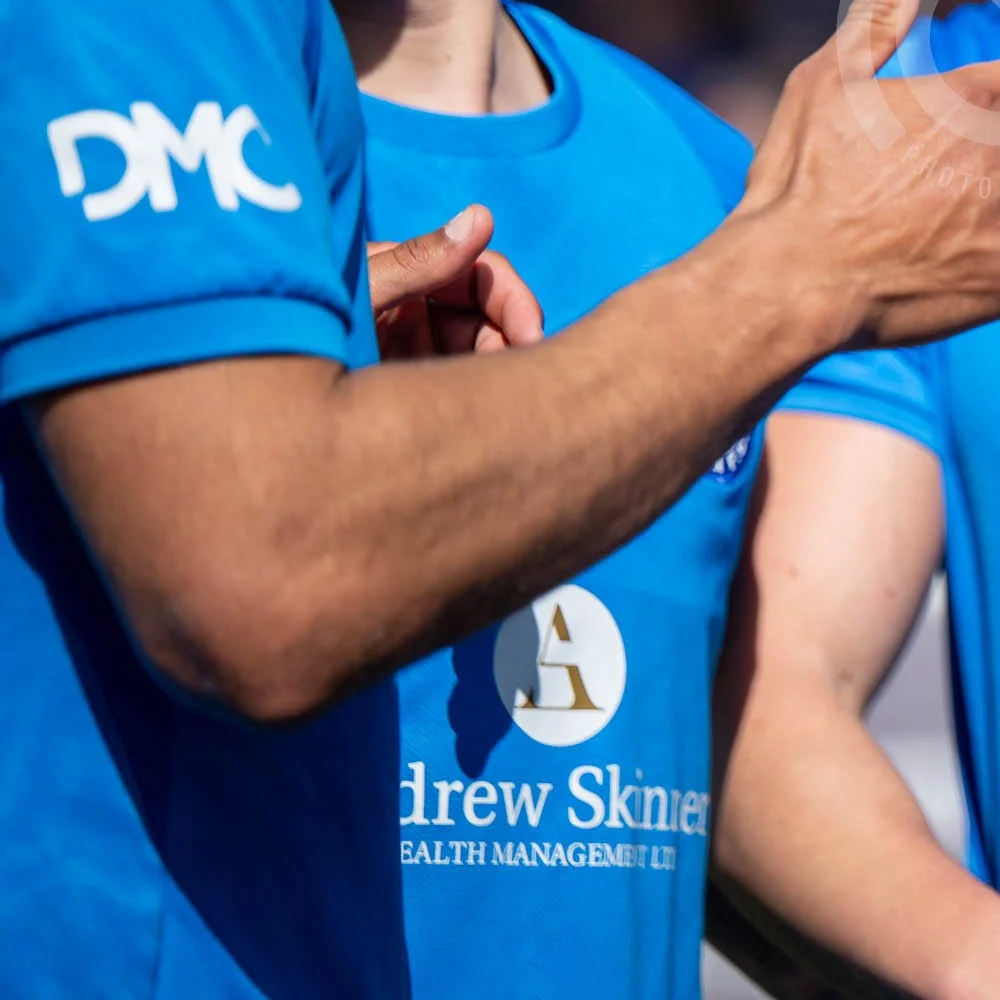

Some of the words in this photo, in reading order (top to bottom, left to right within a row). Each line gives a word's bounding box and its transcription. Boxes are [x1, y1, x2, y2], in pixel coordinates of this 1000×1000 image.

[47, 101, 301, 221] DMC
[400, 761, 554, 827] drew
[401, 840, 487, 866] EALTH
